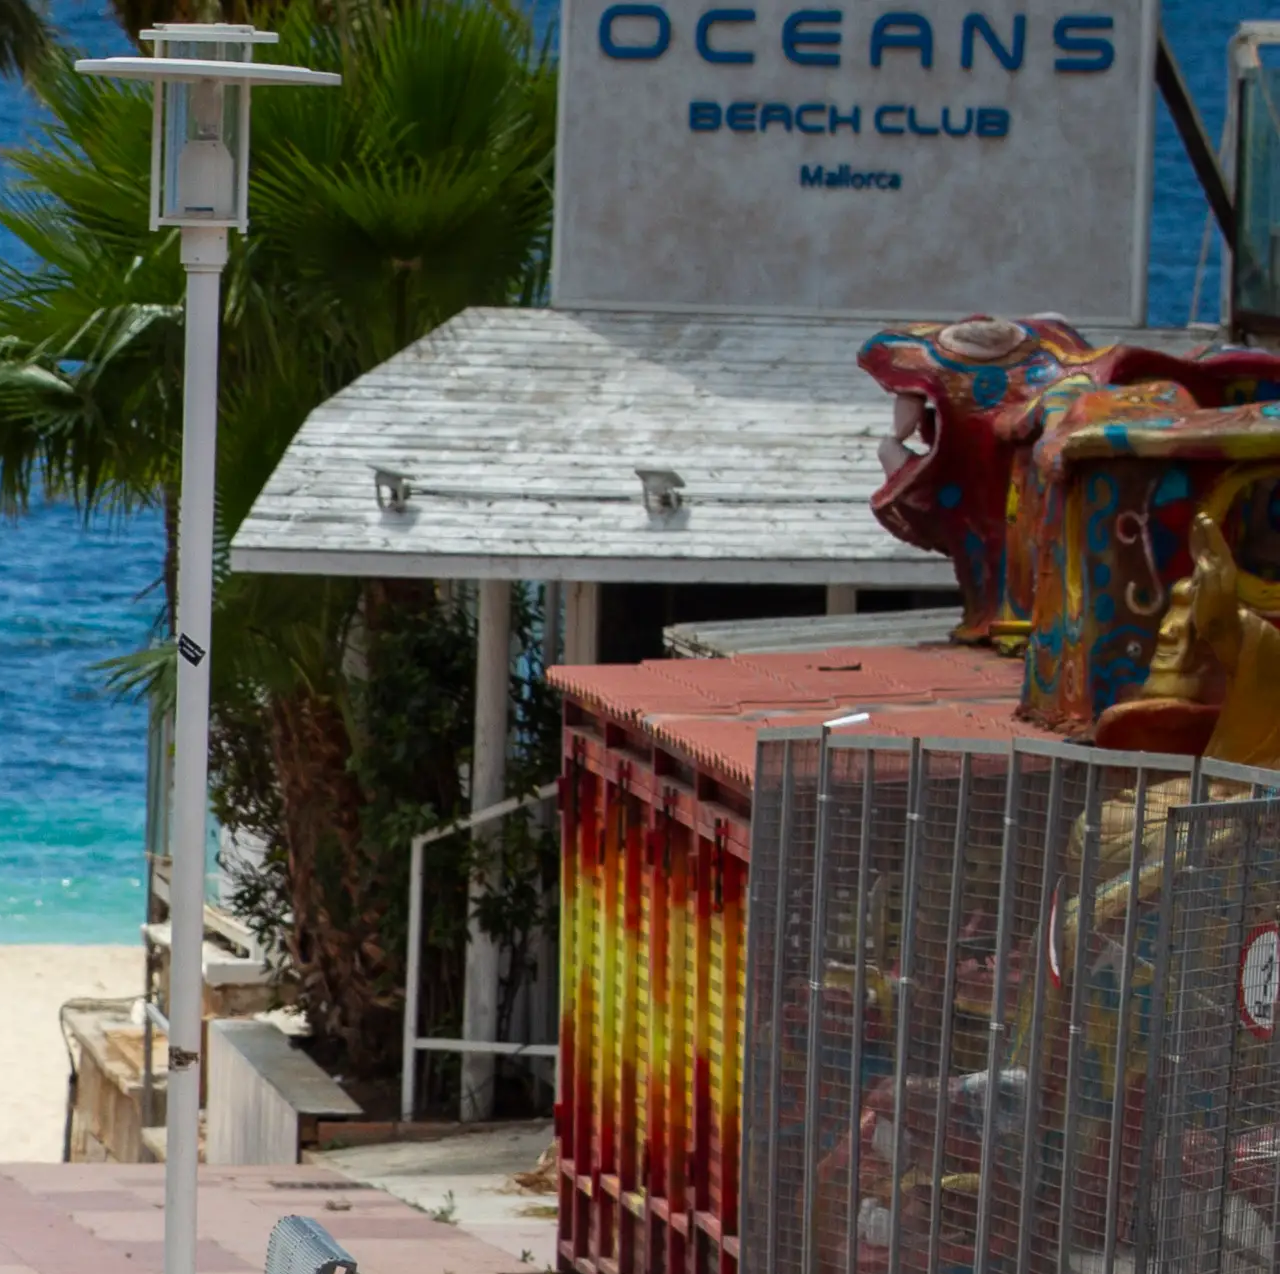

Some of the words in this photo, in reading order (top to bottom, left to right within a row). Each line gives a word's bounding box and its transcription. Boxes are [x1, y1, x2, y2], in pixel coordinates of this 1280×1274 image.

[598, 3, 1115, 72] OCEANS
[689, 100, 861, 134] BEACH
[874, 103, 1012, 138] CLUB
[799, 164, 902, 191] Mallorca
